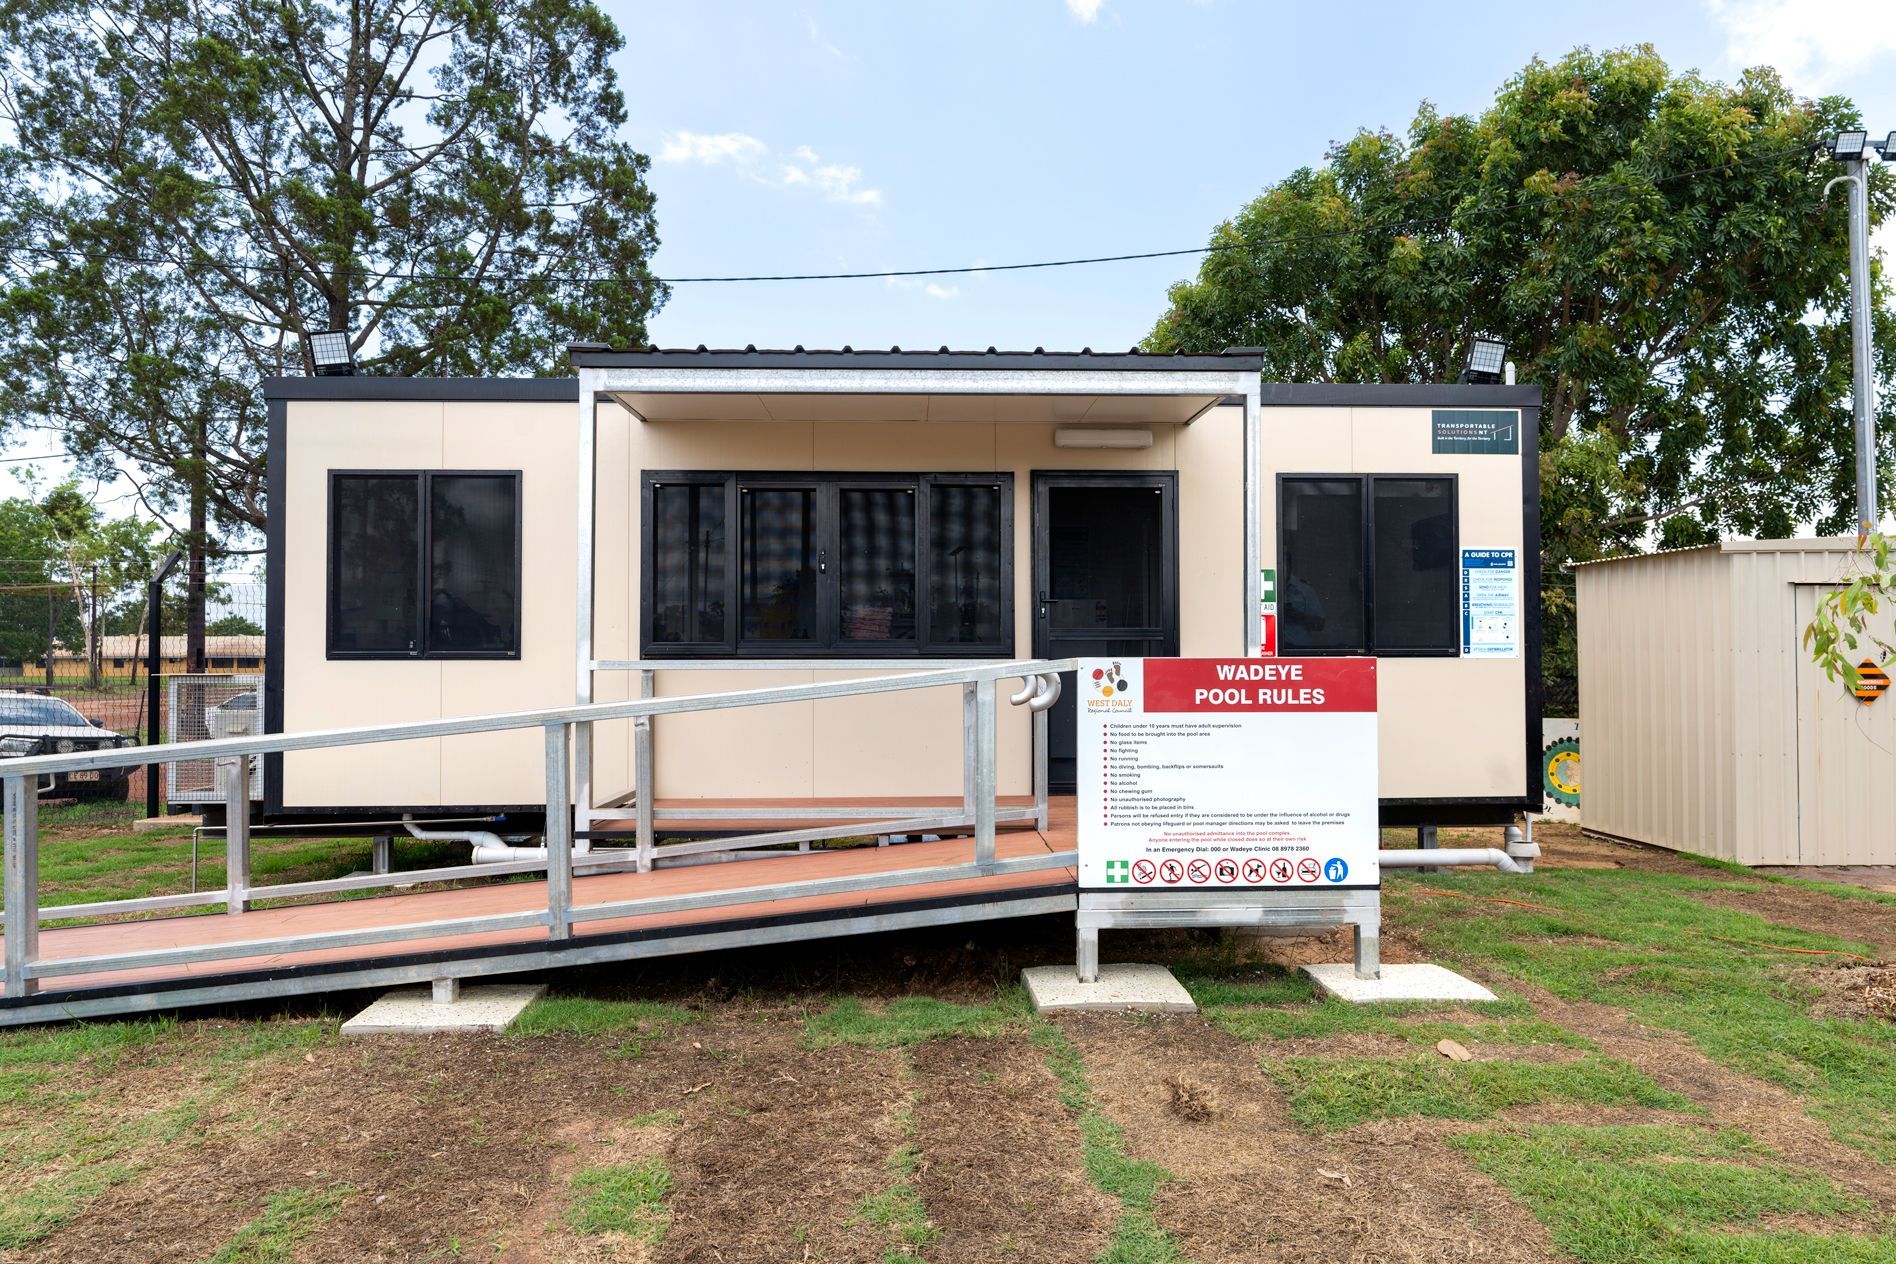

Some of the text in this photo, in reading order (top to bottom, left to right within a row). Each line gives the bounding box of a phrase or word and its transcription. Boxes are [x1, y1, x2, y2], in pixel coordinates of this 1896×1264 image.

[1216, 664, 1303, 681] WADEYE
[1195, 688, 1326, 705] POOL RULES
